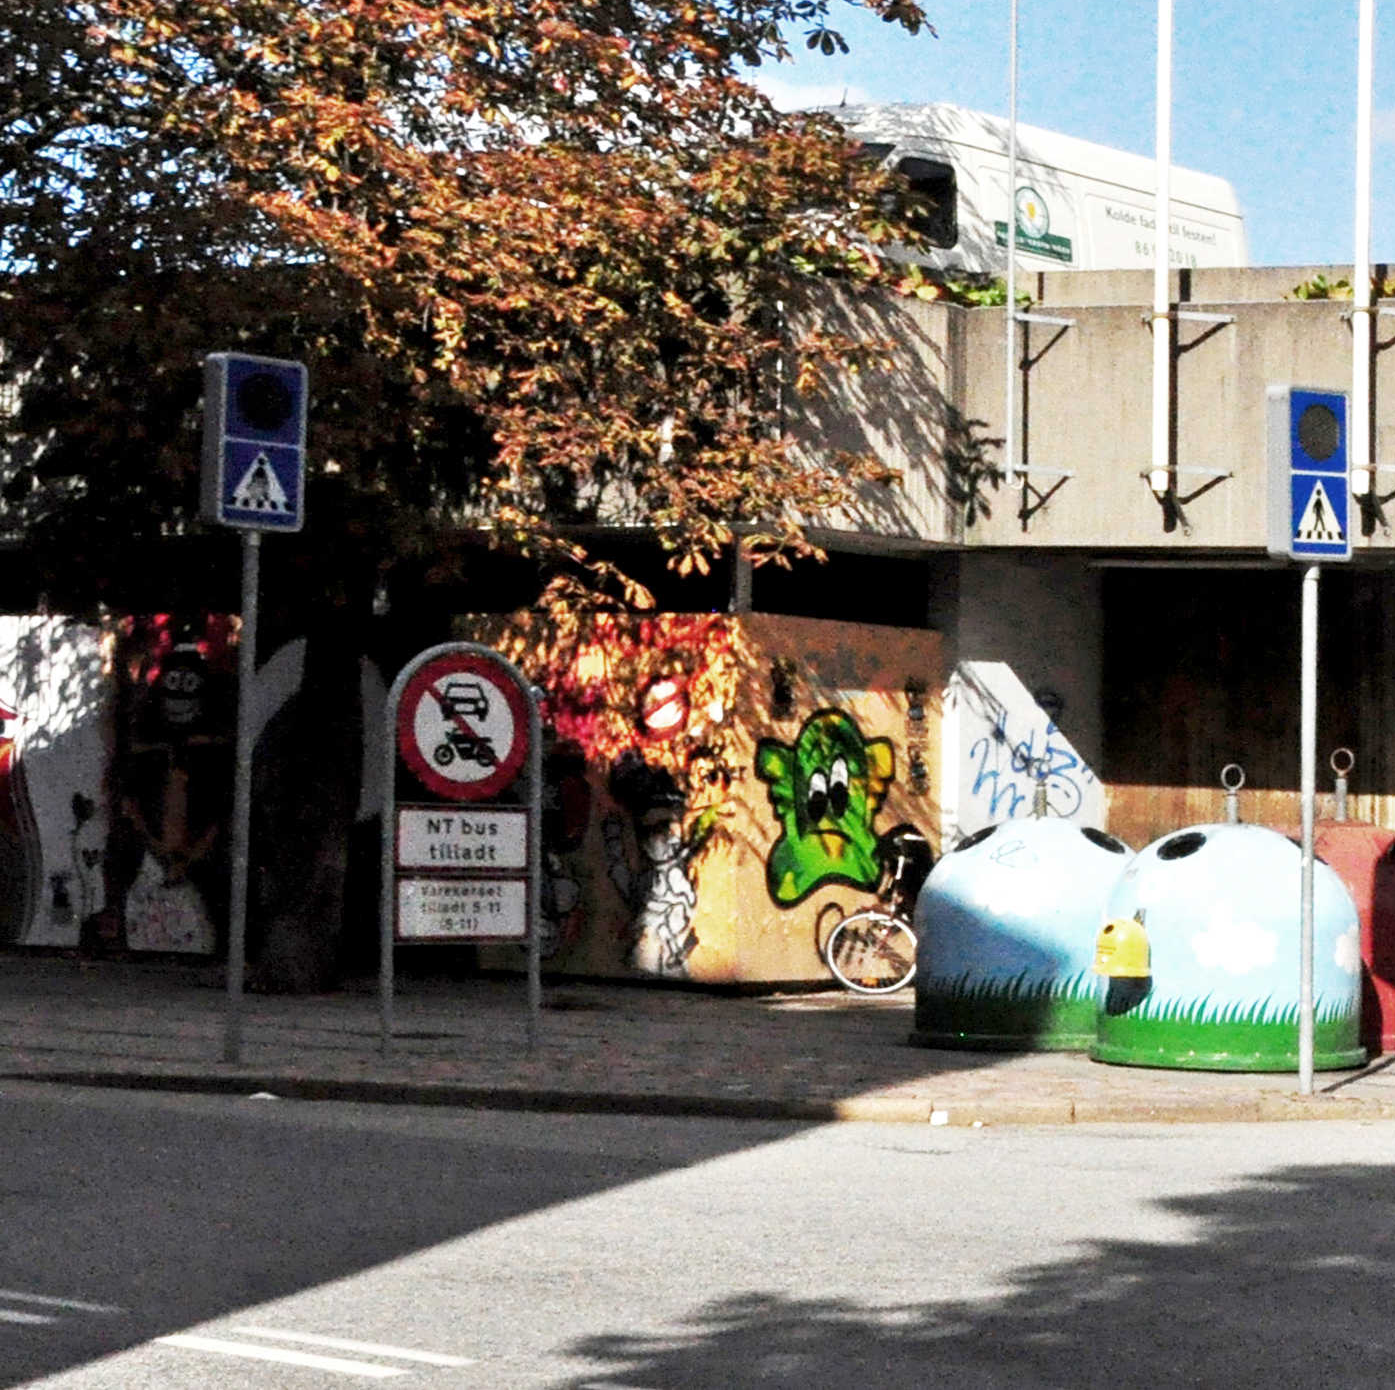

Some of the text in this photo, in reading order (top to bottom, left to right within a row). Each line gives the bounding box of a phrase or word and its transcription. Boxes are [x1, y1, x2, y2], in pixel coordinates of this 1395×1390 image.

[1104, 205, 1136, 225] Kolde
[427, 818, 498, 835] NT bus
[429, 842, 496, 861] tilladt
